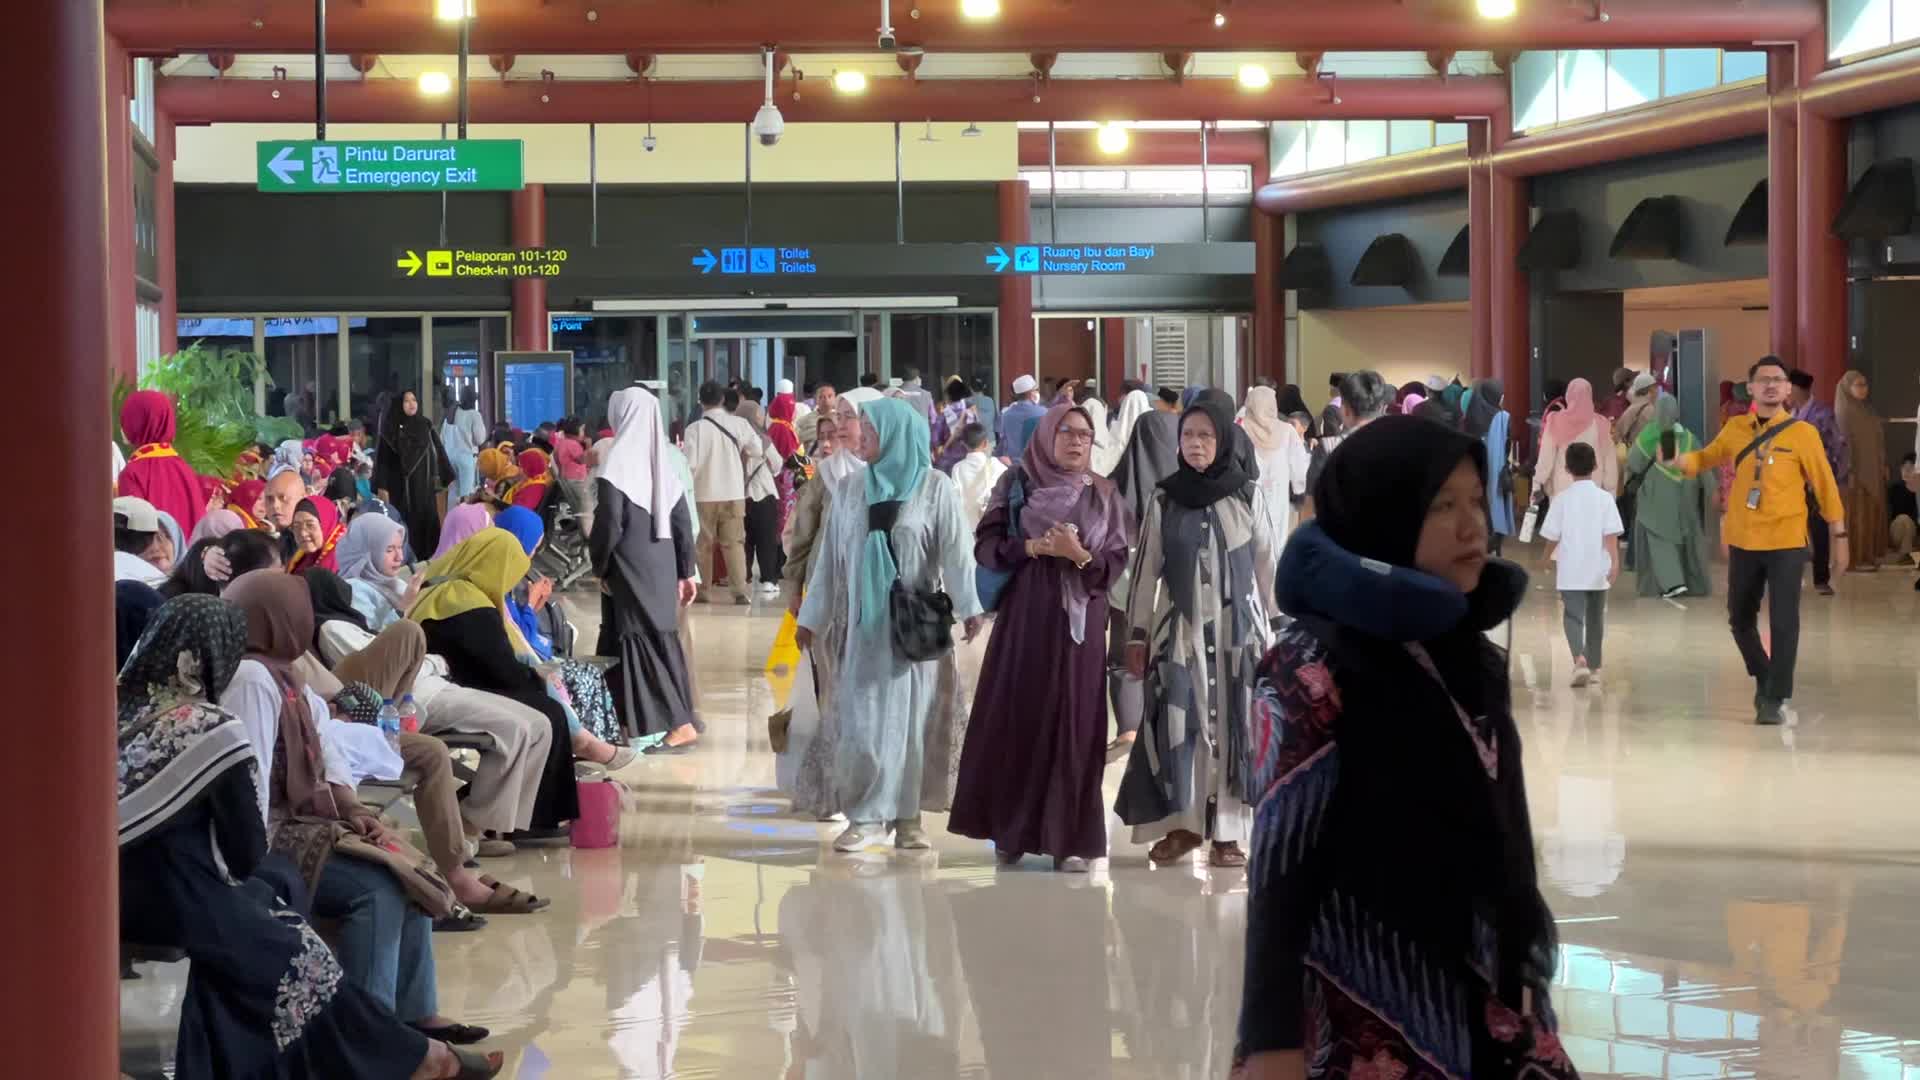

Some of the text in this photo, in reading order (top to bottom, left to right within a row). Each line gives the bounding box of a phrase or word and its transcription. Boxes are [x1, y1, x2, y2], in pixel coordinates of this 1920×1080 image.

[345, 146, 456, 161] Pintu Darurat
[345, 167, 477, 186] Emergency Exit
[456, 250, 567, 263] Pelaporan 101-120
[779, 248, 809, 259] Toilet
[1043, 245, 1154, 259] Ruang Ibu dan Bayi
[456, 264, 560, 276] Check-in 101-120
[780, 262, 817, 272] Toilets
[1043, 260, 1126, 273] Nursery Room
[560, 321, 582, 330] Point
